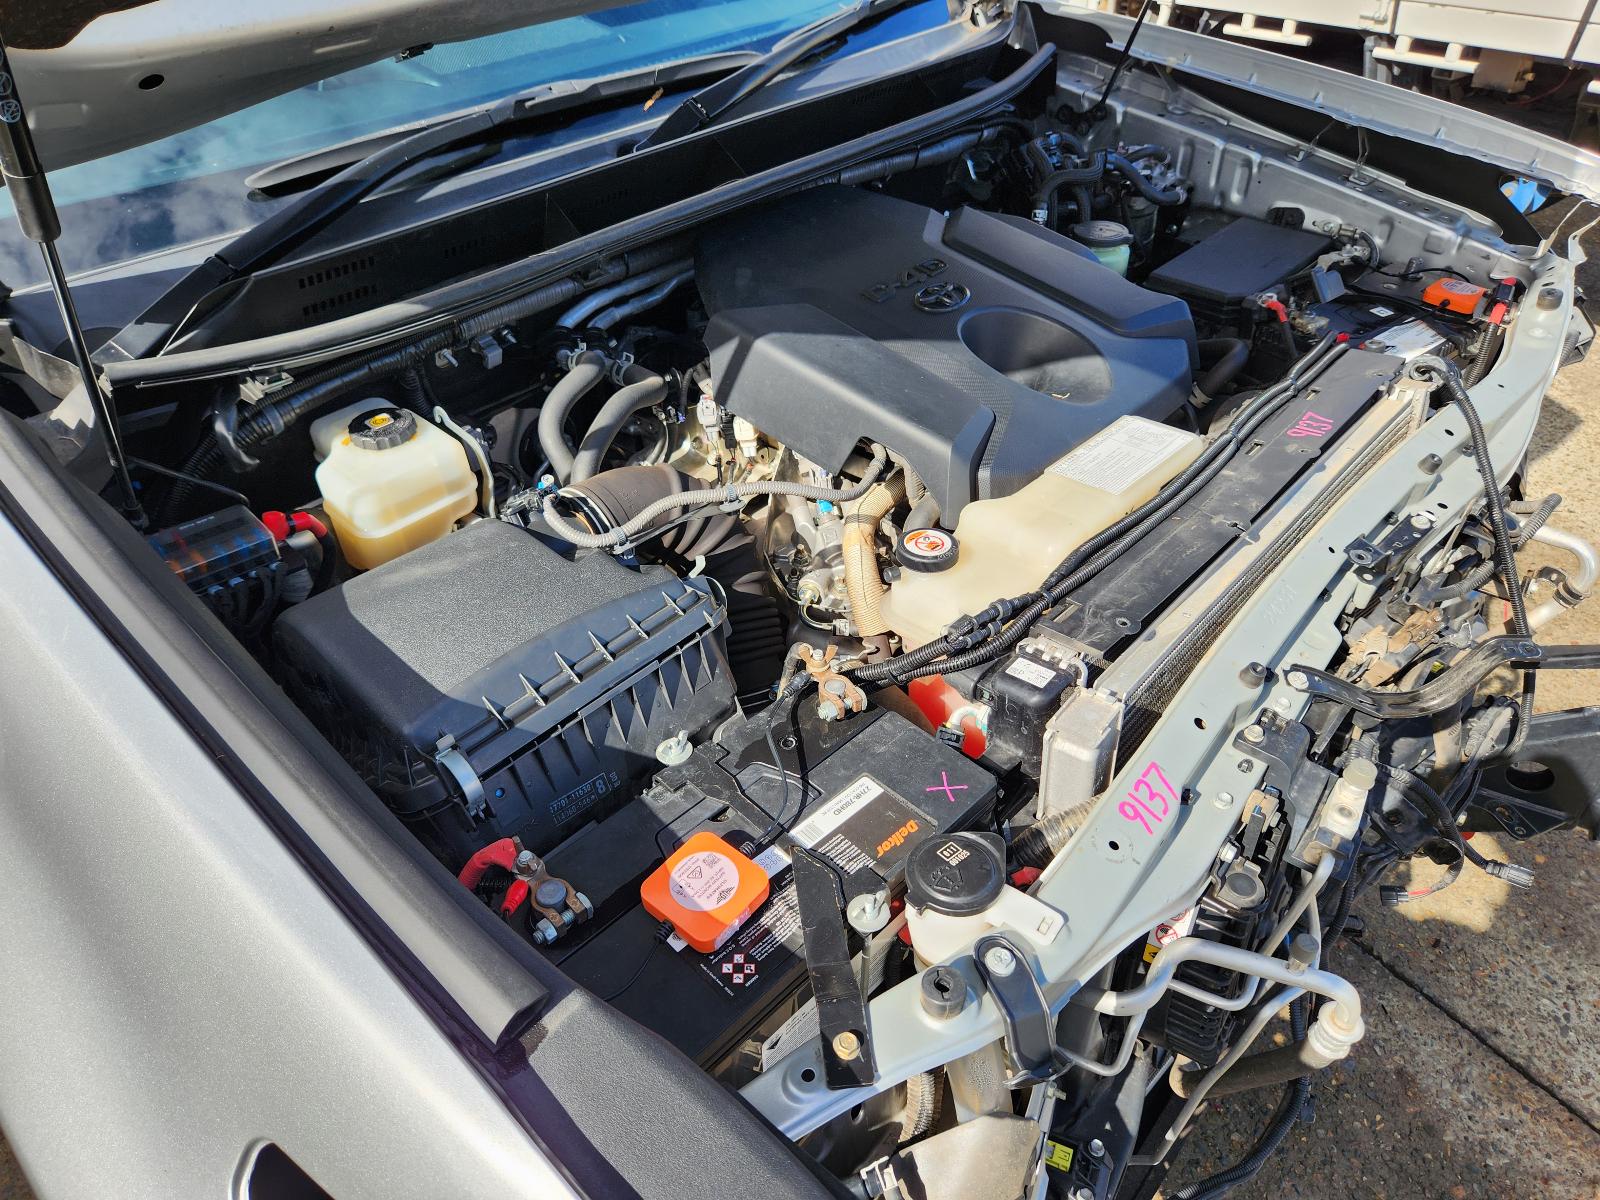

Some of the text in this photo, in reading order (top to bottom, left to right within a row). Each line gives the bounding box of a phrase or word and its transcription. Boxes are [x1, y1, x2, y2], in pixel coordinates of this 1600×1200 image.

[1286, 410, 1333, 437] 9137
[832, 785, 871, 816] 27HR-780HD
[1119, 761, 1179, 835] 9137
[875, 819, 919, 858] Delkor
